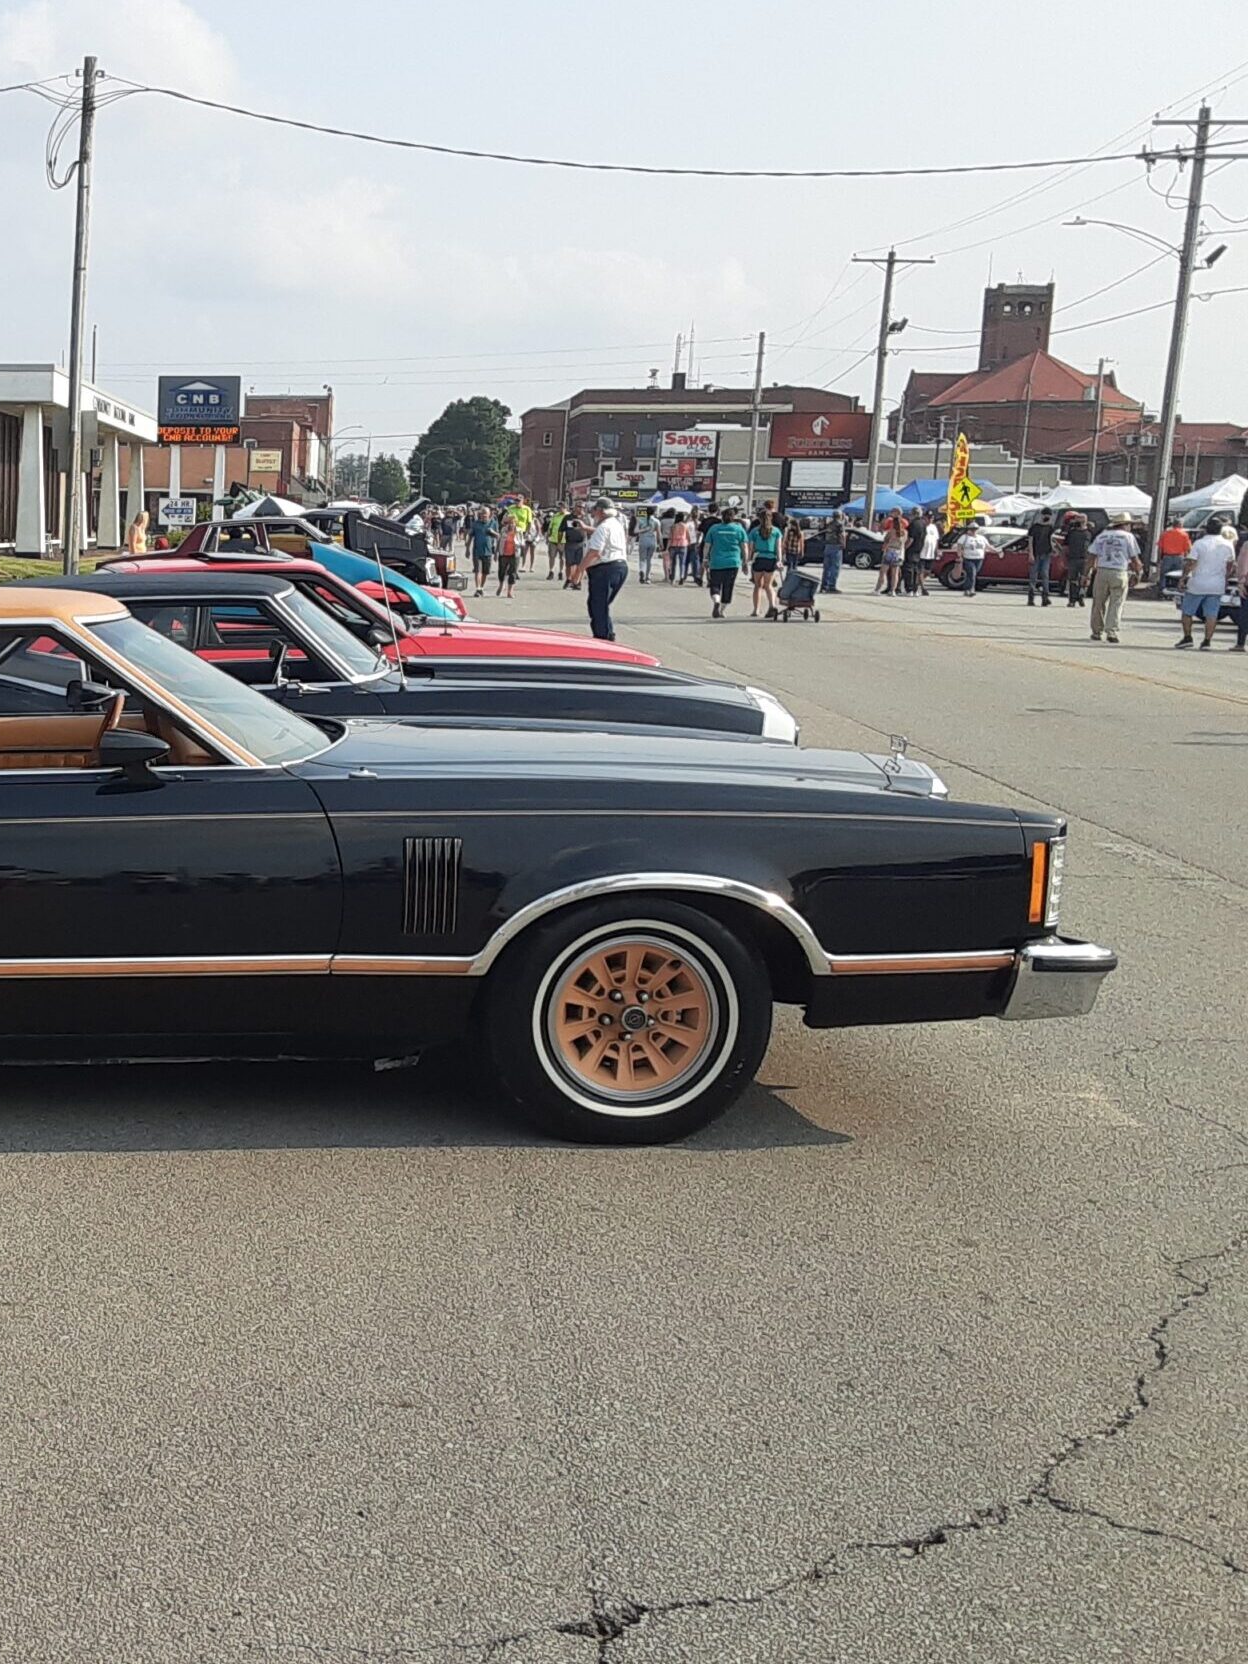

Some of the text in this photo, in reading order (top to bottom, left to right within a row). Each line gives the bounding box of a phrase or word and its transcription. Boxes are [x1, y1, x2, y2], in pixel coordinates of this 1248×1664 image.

[176, 393, 221, 405] CNB
[159, 426, 239, 435] DEPOSIT TO YOUR
[163, 433, 182, 442] CNB
[664, 432, 711, 446] Save
